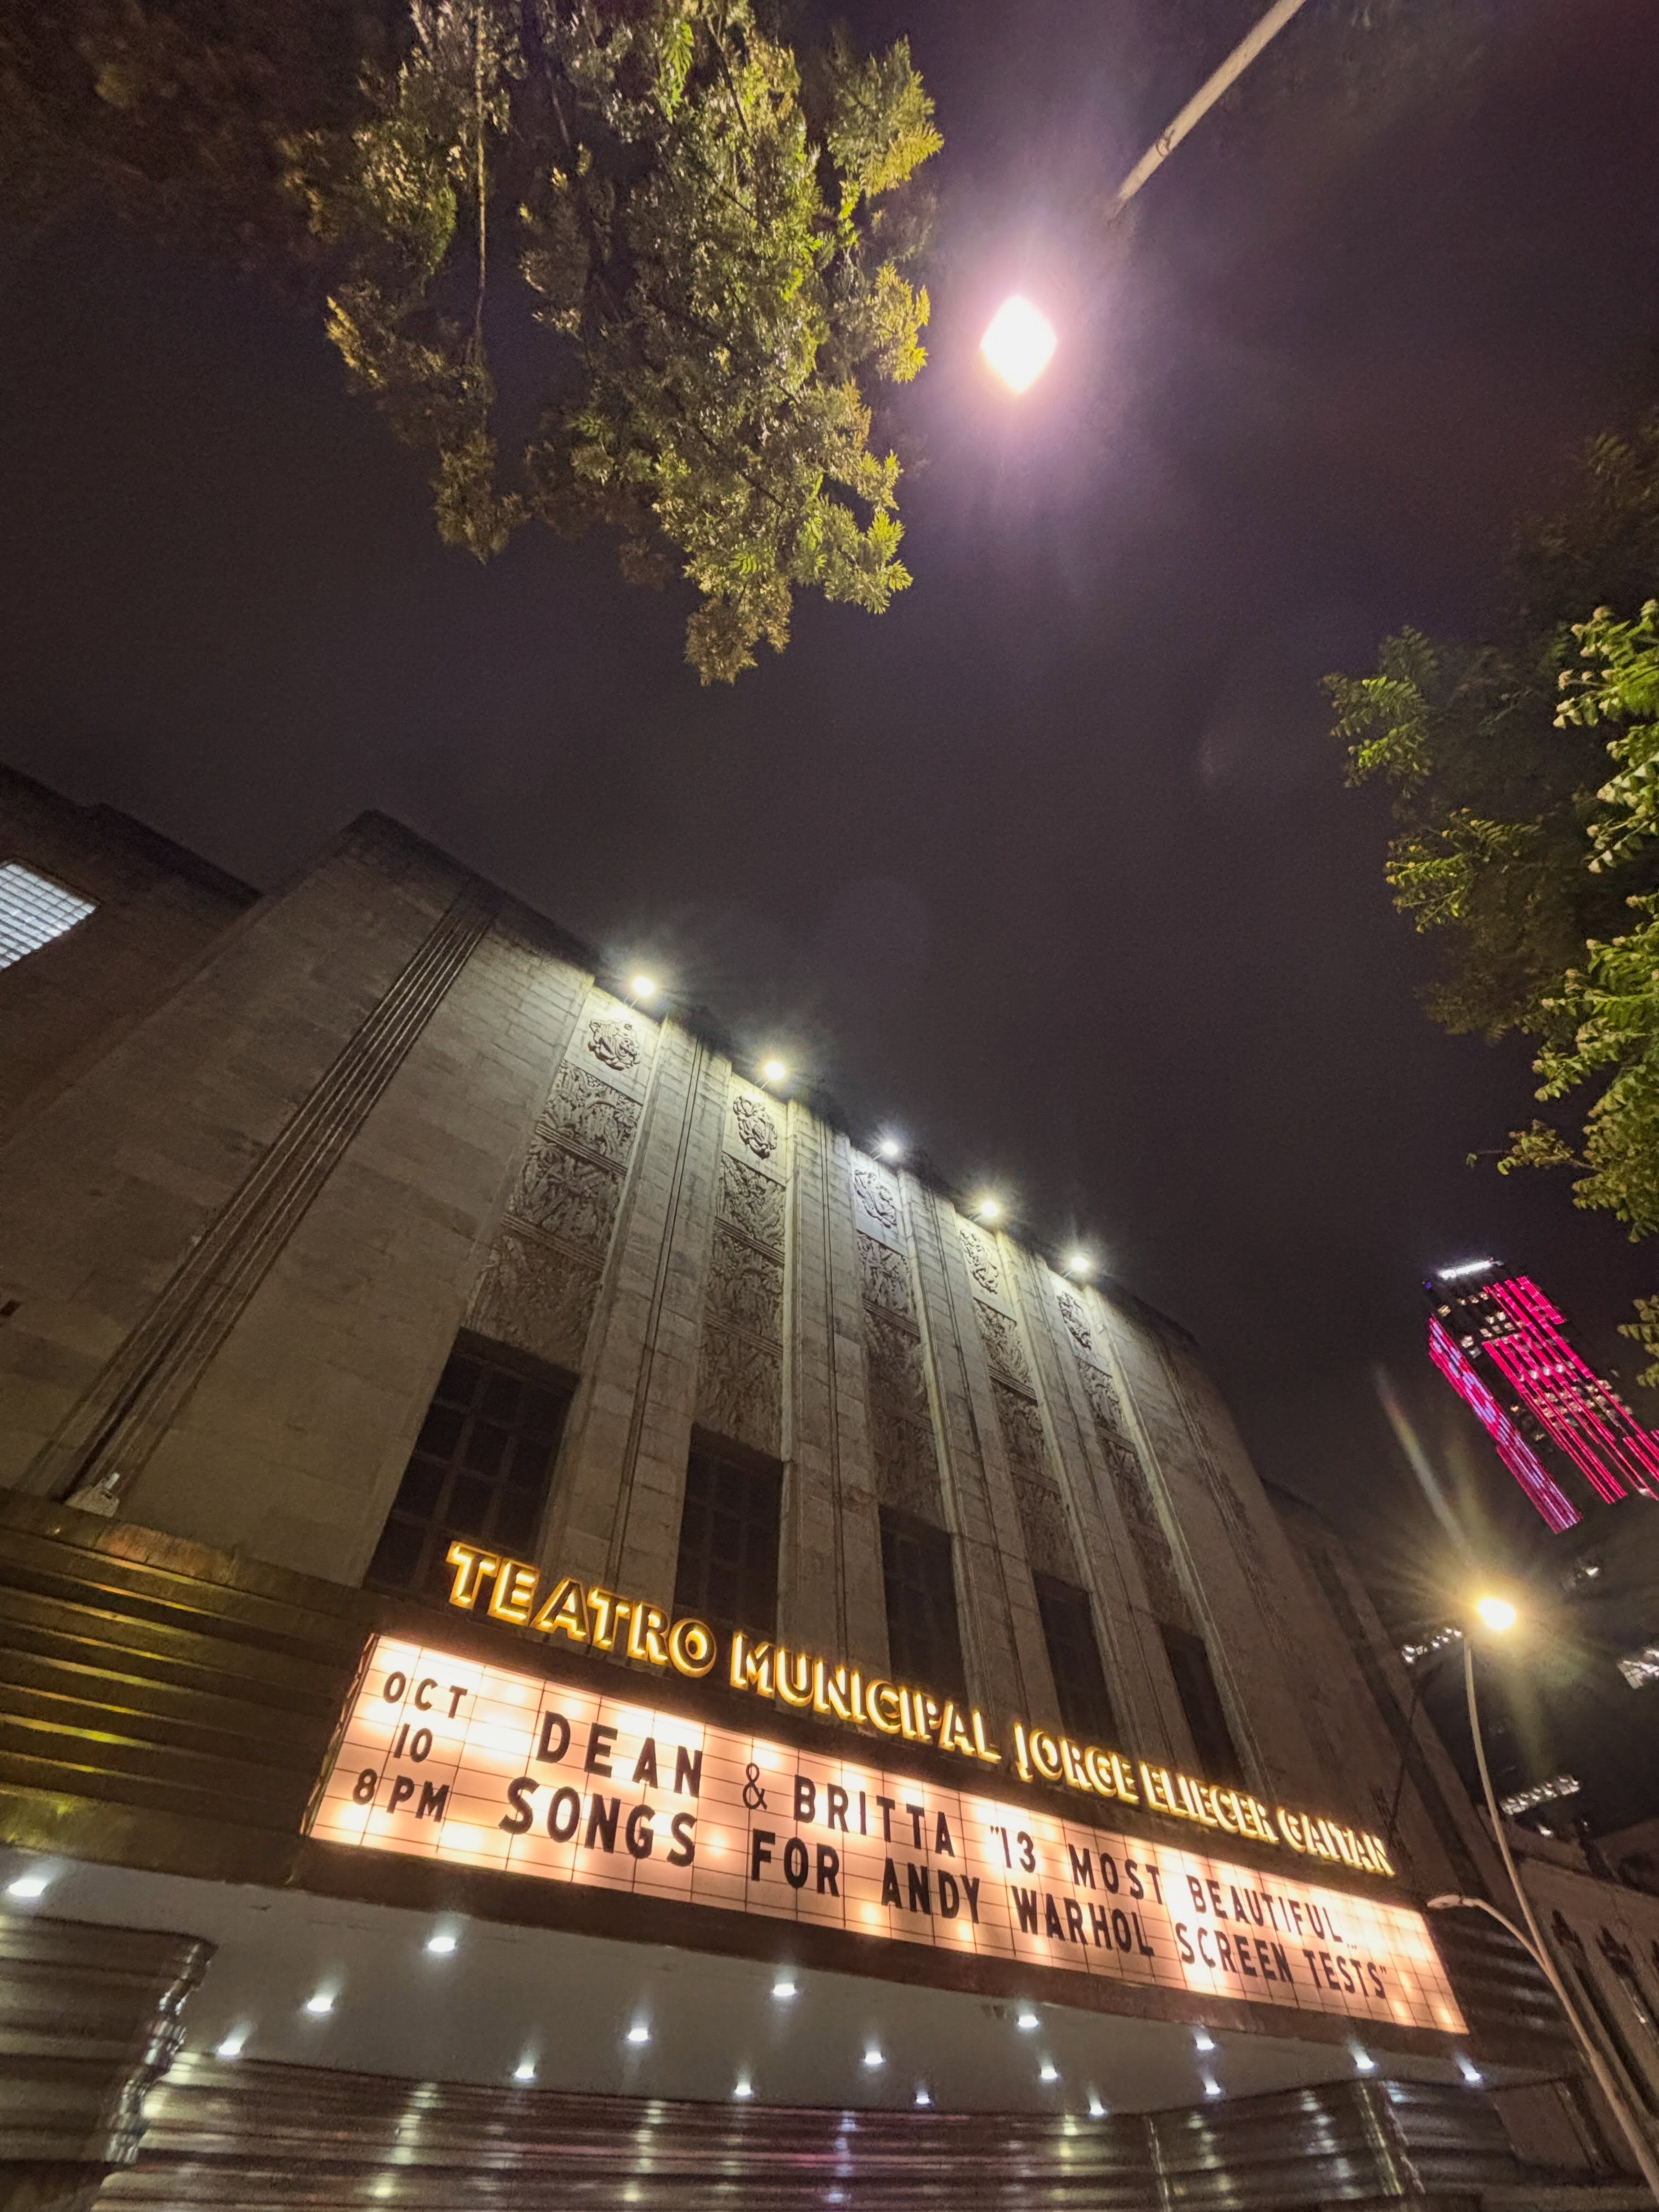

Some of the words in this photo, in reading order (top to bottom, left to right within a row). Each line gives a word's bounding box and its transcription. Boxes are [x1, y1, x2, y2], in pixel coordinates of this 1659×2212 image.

[383, 1671, 467, 1719] OCT
[393, 1723, 433, 1763] 10
[445, 1539, 717, 1678] TEATRO
[729, 1630, 1002, 1764] MUNICIPAL
[1013, 1722, 1140, 1805] JORGE
[498, 1776, 698, 1867] SONGS
[751, 1828, 840, 1897] FOR
[881, 1858, 980, 1924] ANDY
[1011, 1885, 1155, 1957] WARHOL
[1175, 1922, 1294, 1983] SCREEN
[1302, 1948, 1387, 2000] TESTS"
[535, 1710, 703, 1798] DEAN
[742, 1763, 768, 1810] &
[794, 1774, 955, 1857] BRITTA
[1068, 1843, 1164, 1905] MOST
